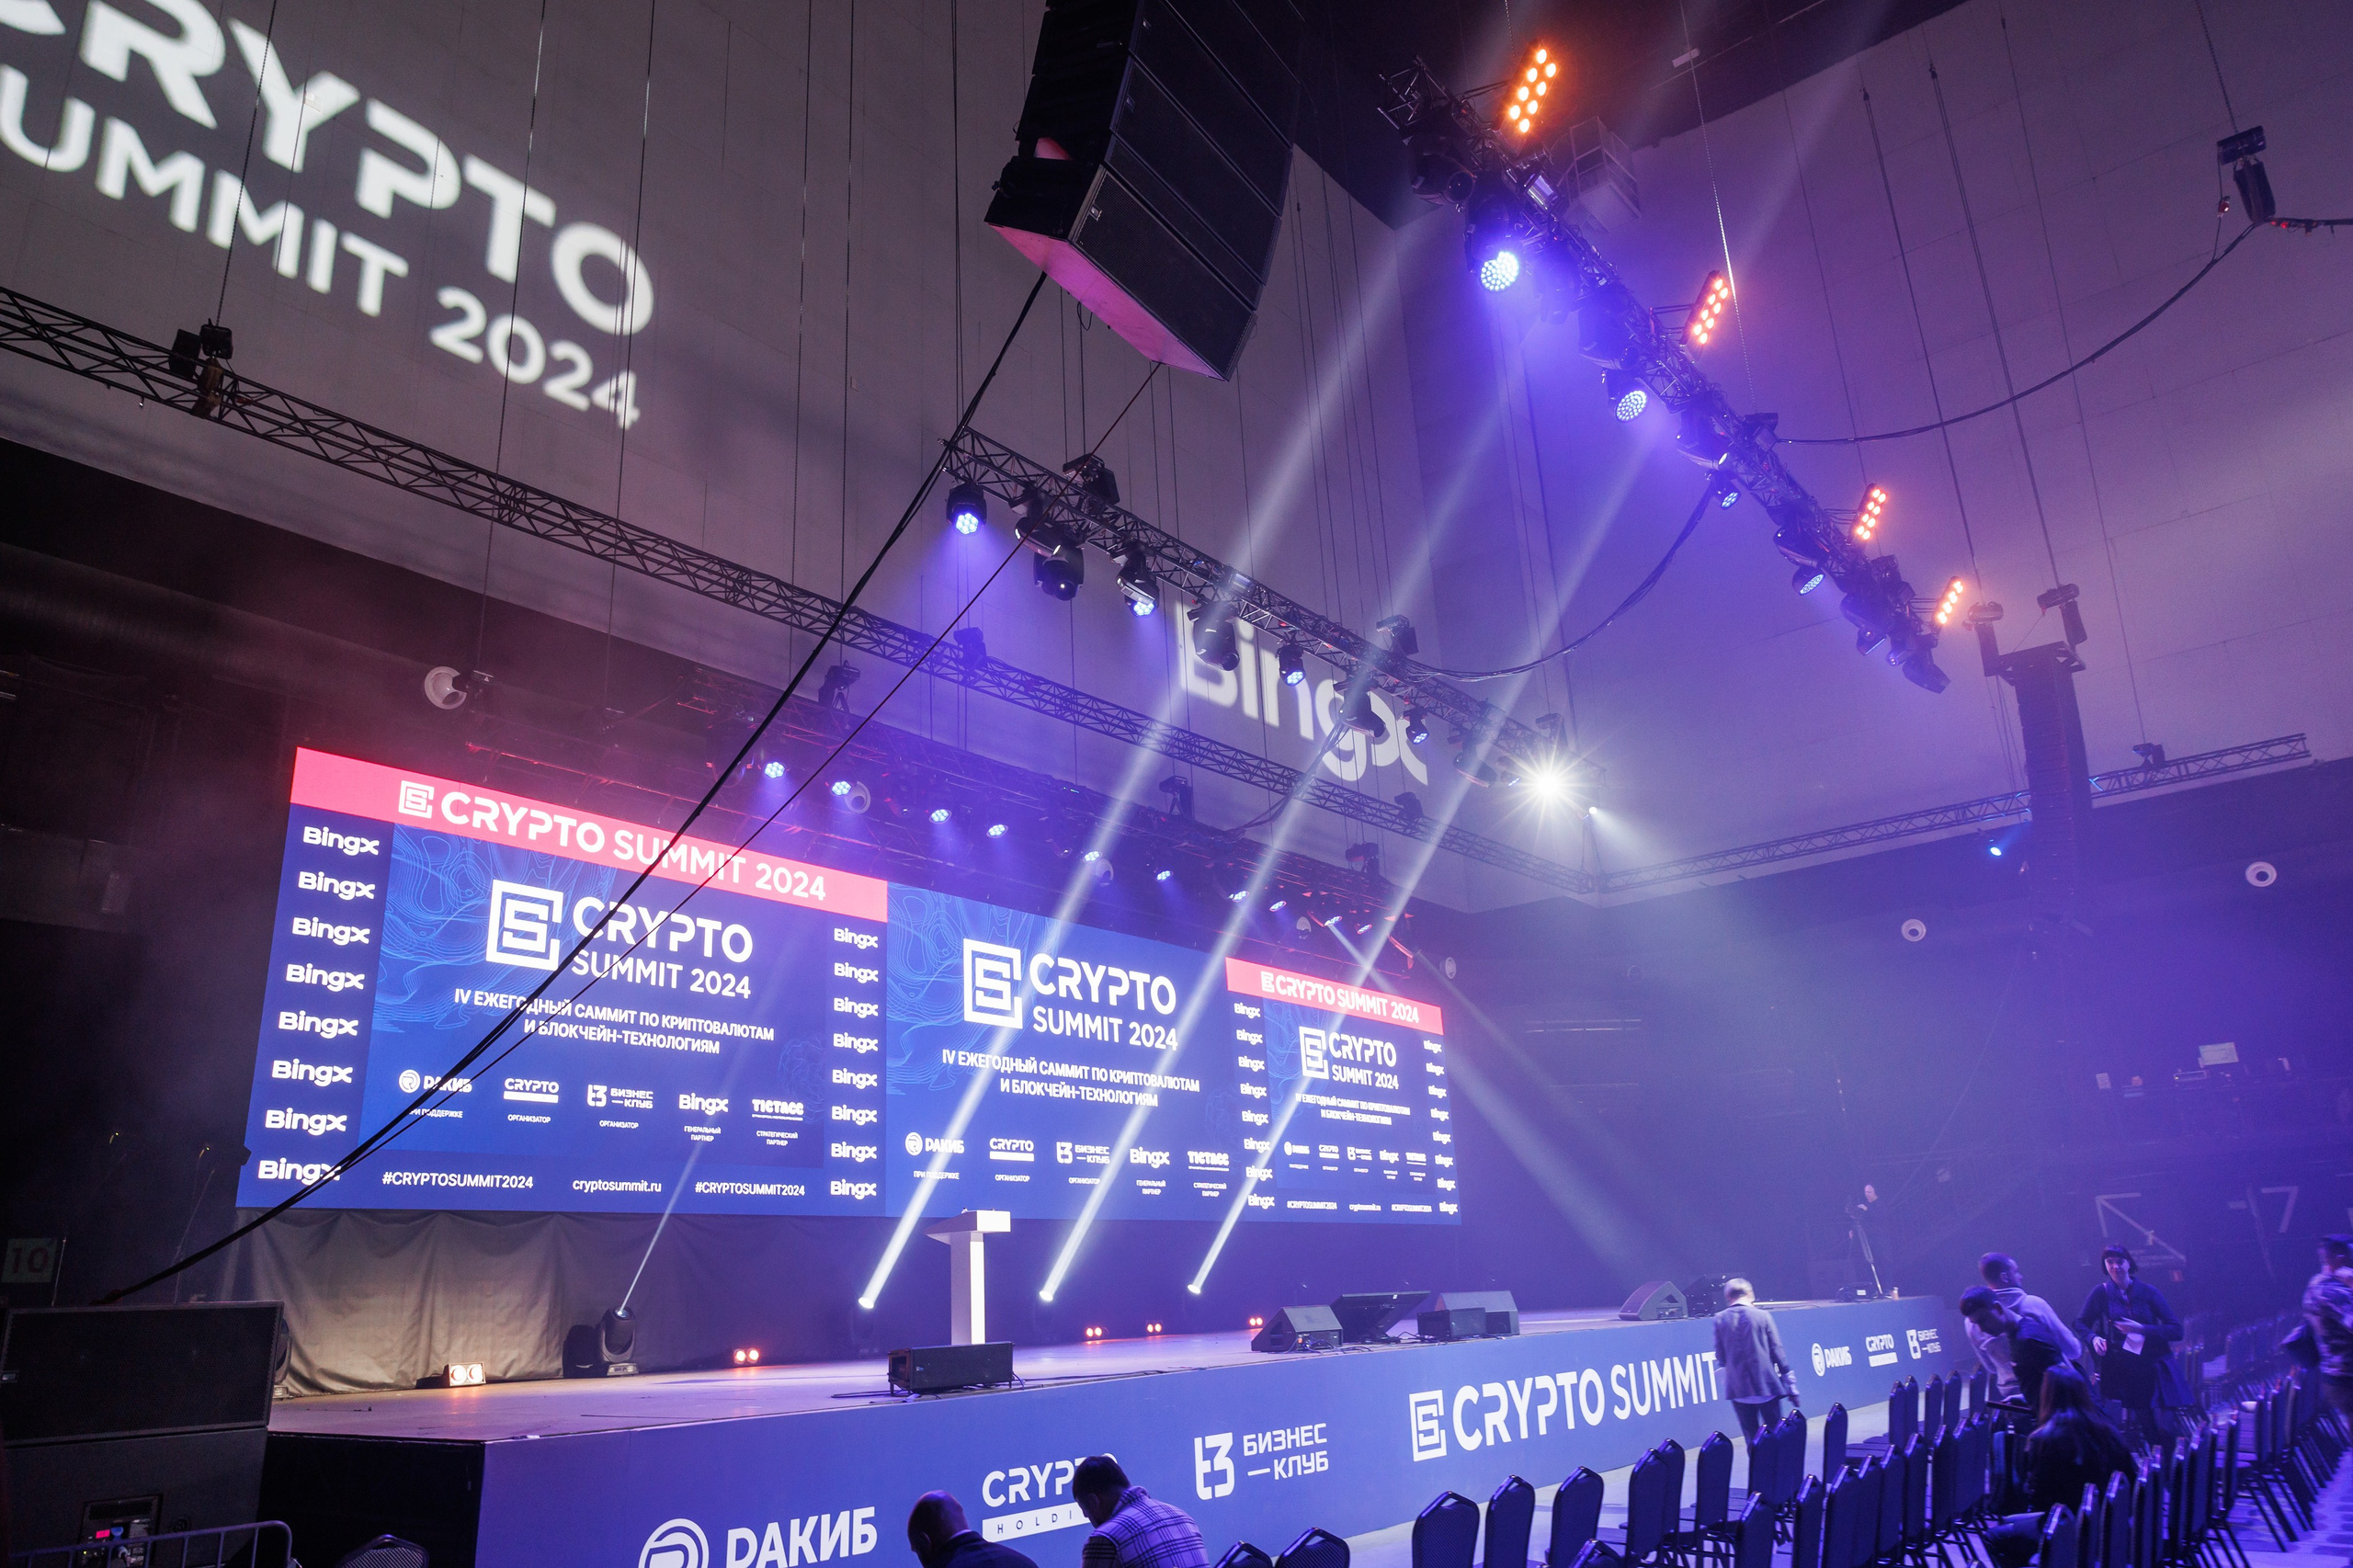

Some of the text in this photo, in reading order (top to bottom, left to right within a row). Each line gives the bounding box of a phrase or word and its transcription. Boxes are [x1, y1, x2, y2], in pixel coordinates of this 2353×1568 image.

[0, 0, 654, 335] RYPTO
[0, 64, 641, 429] UMMIT 2024
[441, 792, 605, 852] CRYPTO
[613, 830, 745, 882] SUMMIT
[756, 863, 825, 901] 2024
[574, 897, 753, 962] CRYPTO
[572, 949, 750, 998] SUMMIT 2024
[1029, 953, 1176, 1014] CRYPTO
[455, 989, 774, 1040] IV ЕЖЕГОДНЫЙ САММИТ ПО КРИПТОВАЛЮТАМ
[1276, 975, 1419, 1023] CRYPTO SUMMIT 2024
[525, 1019, 720, 1053] И БЛОКЧЕЙН-ТЕХНОЛОГИЯМ
[1033, 1006, 1177, 1051] SUMMIT 2024
[943, 1050, 955, 1063] IV
[959, 1051, 1037, 1074] ЕЖЕГОДНЫЙ
[1040, 1062, 1089, 1079] САММИТ
[1092, 1067, 1108, 1081] ПО
[1329, 1032, 1396, 1066] CRYPTO
[505, 1078, 559, 1093] CRYPTO
[610, 1087, 654, 1099] БИЗНЕС
[1001, 1078, 1009, 1092] И
[1332, 1065, 1399, 1089] SUMMIT 2024
[989, 1138, 1034, 1152] CRYPTO
[382, 1172, 533, 1187] #CRYPTOSUMMIT2024
[573, 1180, 661, 1192] cryptosummit.ru
[696, 1182, 804, 1195] #CRYPTOSUMMIT2024
[13, 1247, 49, 1274] 10
[1453, 1369, 1605, 1450] CRYPTO
[1611, 1352, 1720, 1419] SUMMIT
[1243, 1423, 1327, 1457] БИЗНЕС
[997, 1509, 1073, 1535] HOLDI
